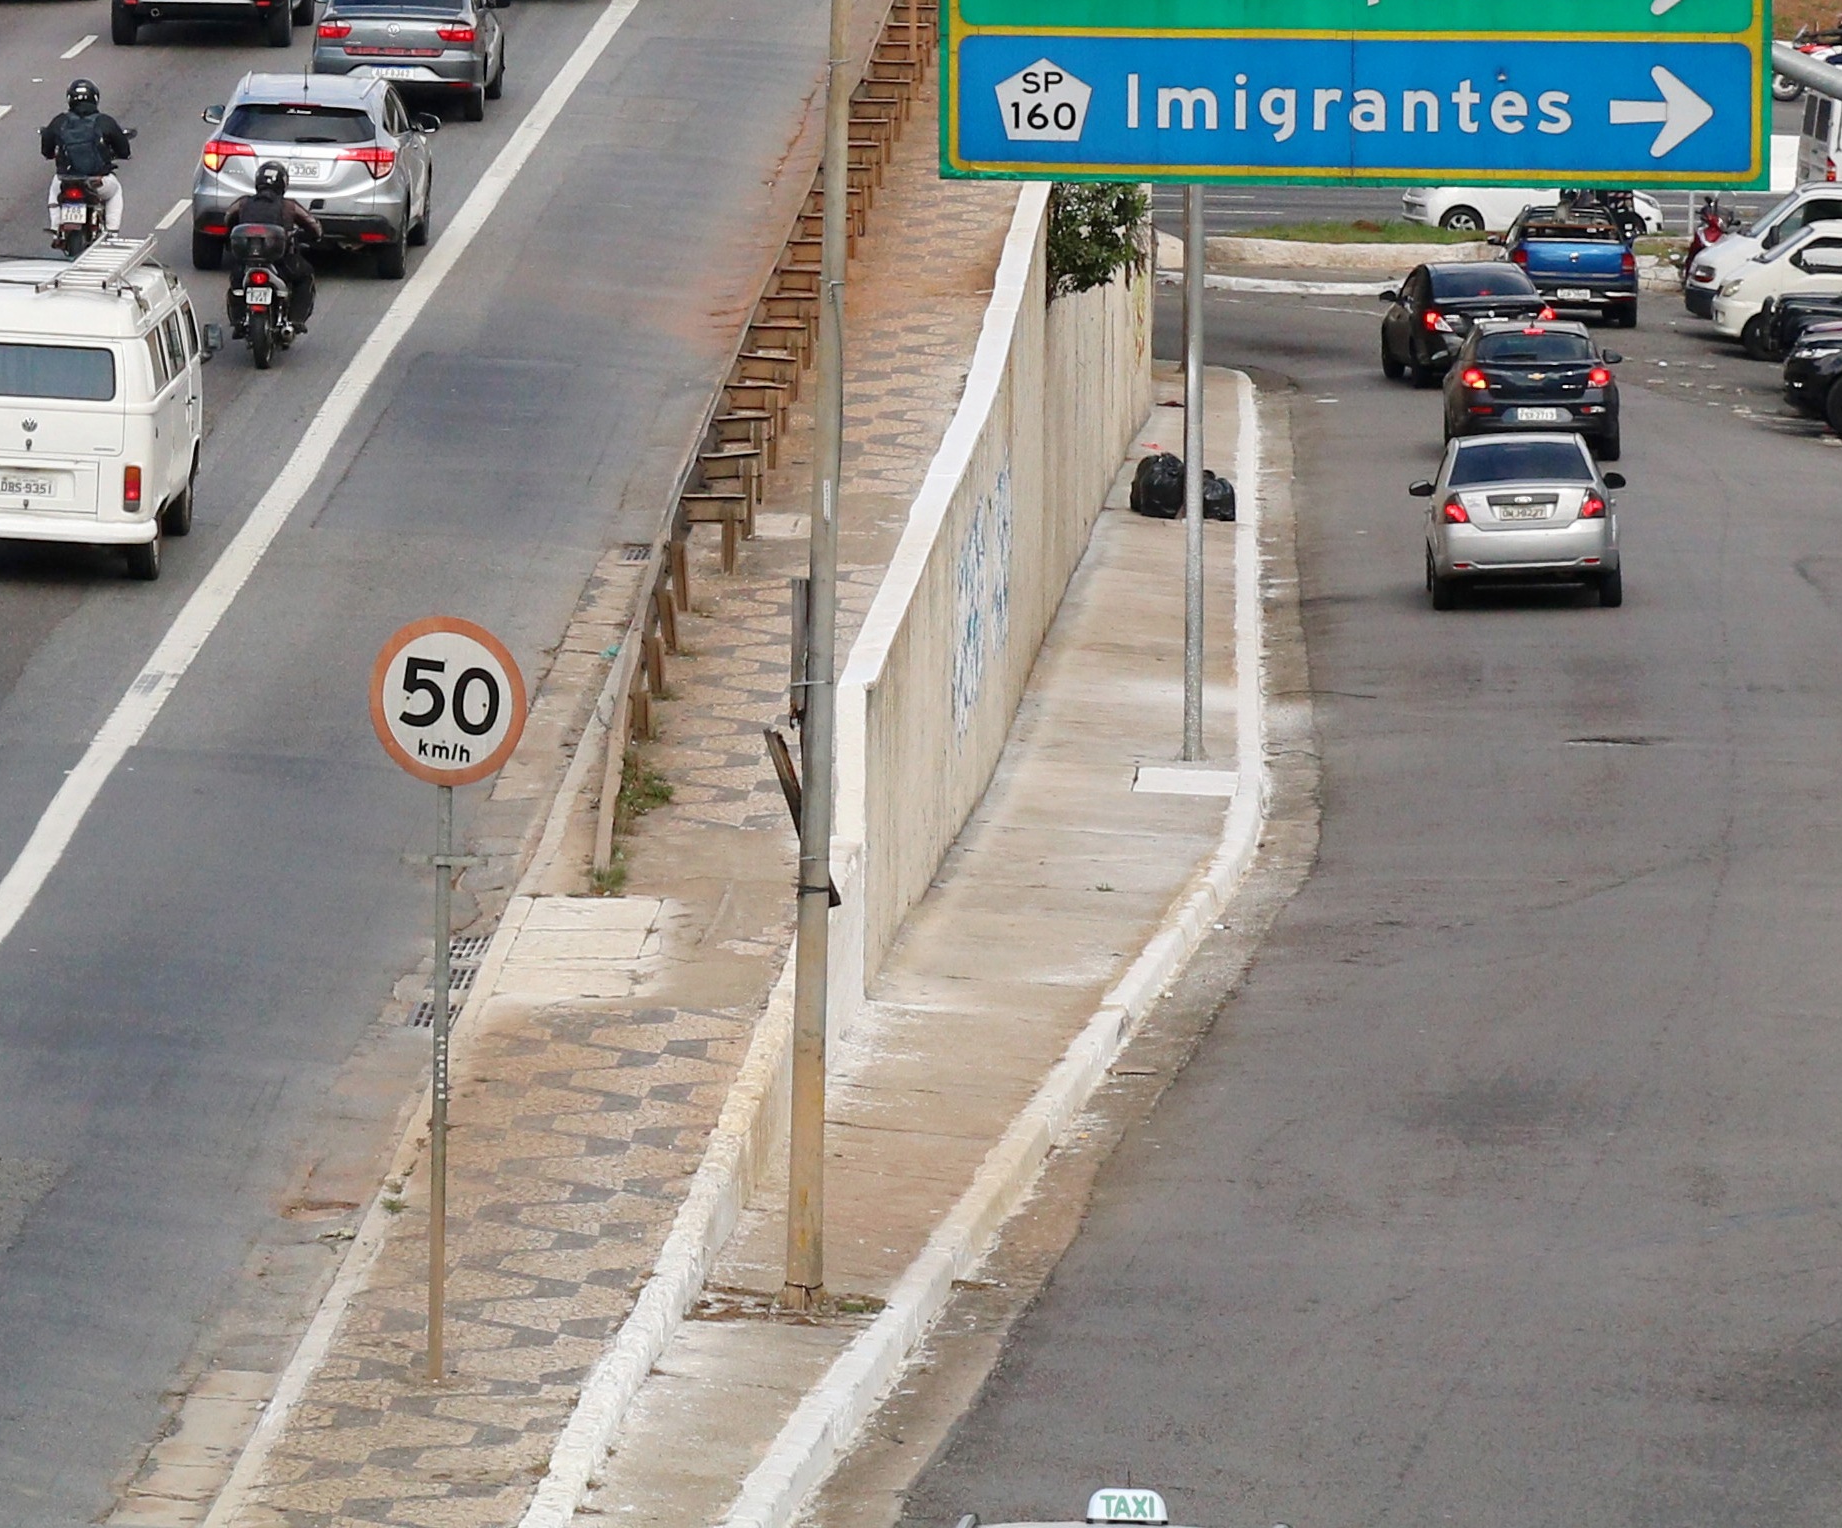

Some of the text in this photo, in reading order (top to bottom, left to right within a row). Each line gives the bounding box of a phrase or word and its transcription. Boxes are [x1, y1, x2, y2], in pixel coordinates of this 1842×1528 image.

[1021, 71, 1064, 94] SP
[1010, 102, 1077, 132] 160
[1127, 71, 1573, 143] Imigrantes
[399, 656, 500, 736] 50
[418, 740, 471, 763] km/h
[1100, 1494, 1155, 1519] TAXI
